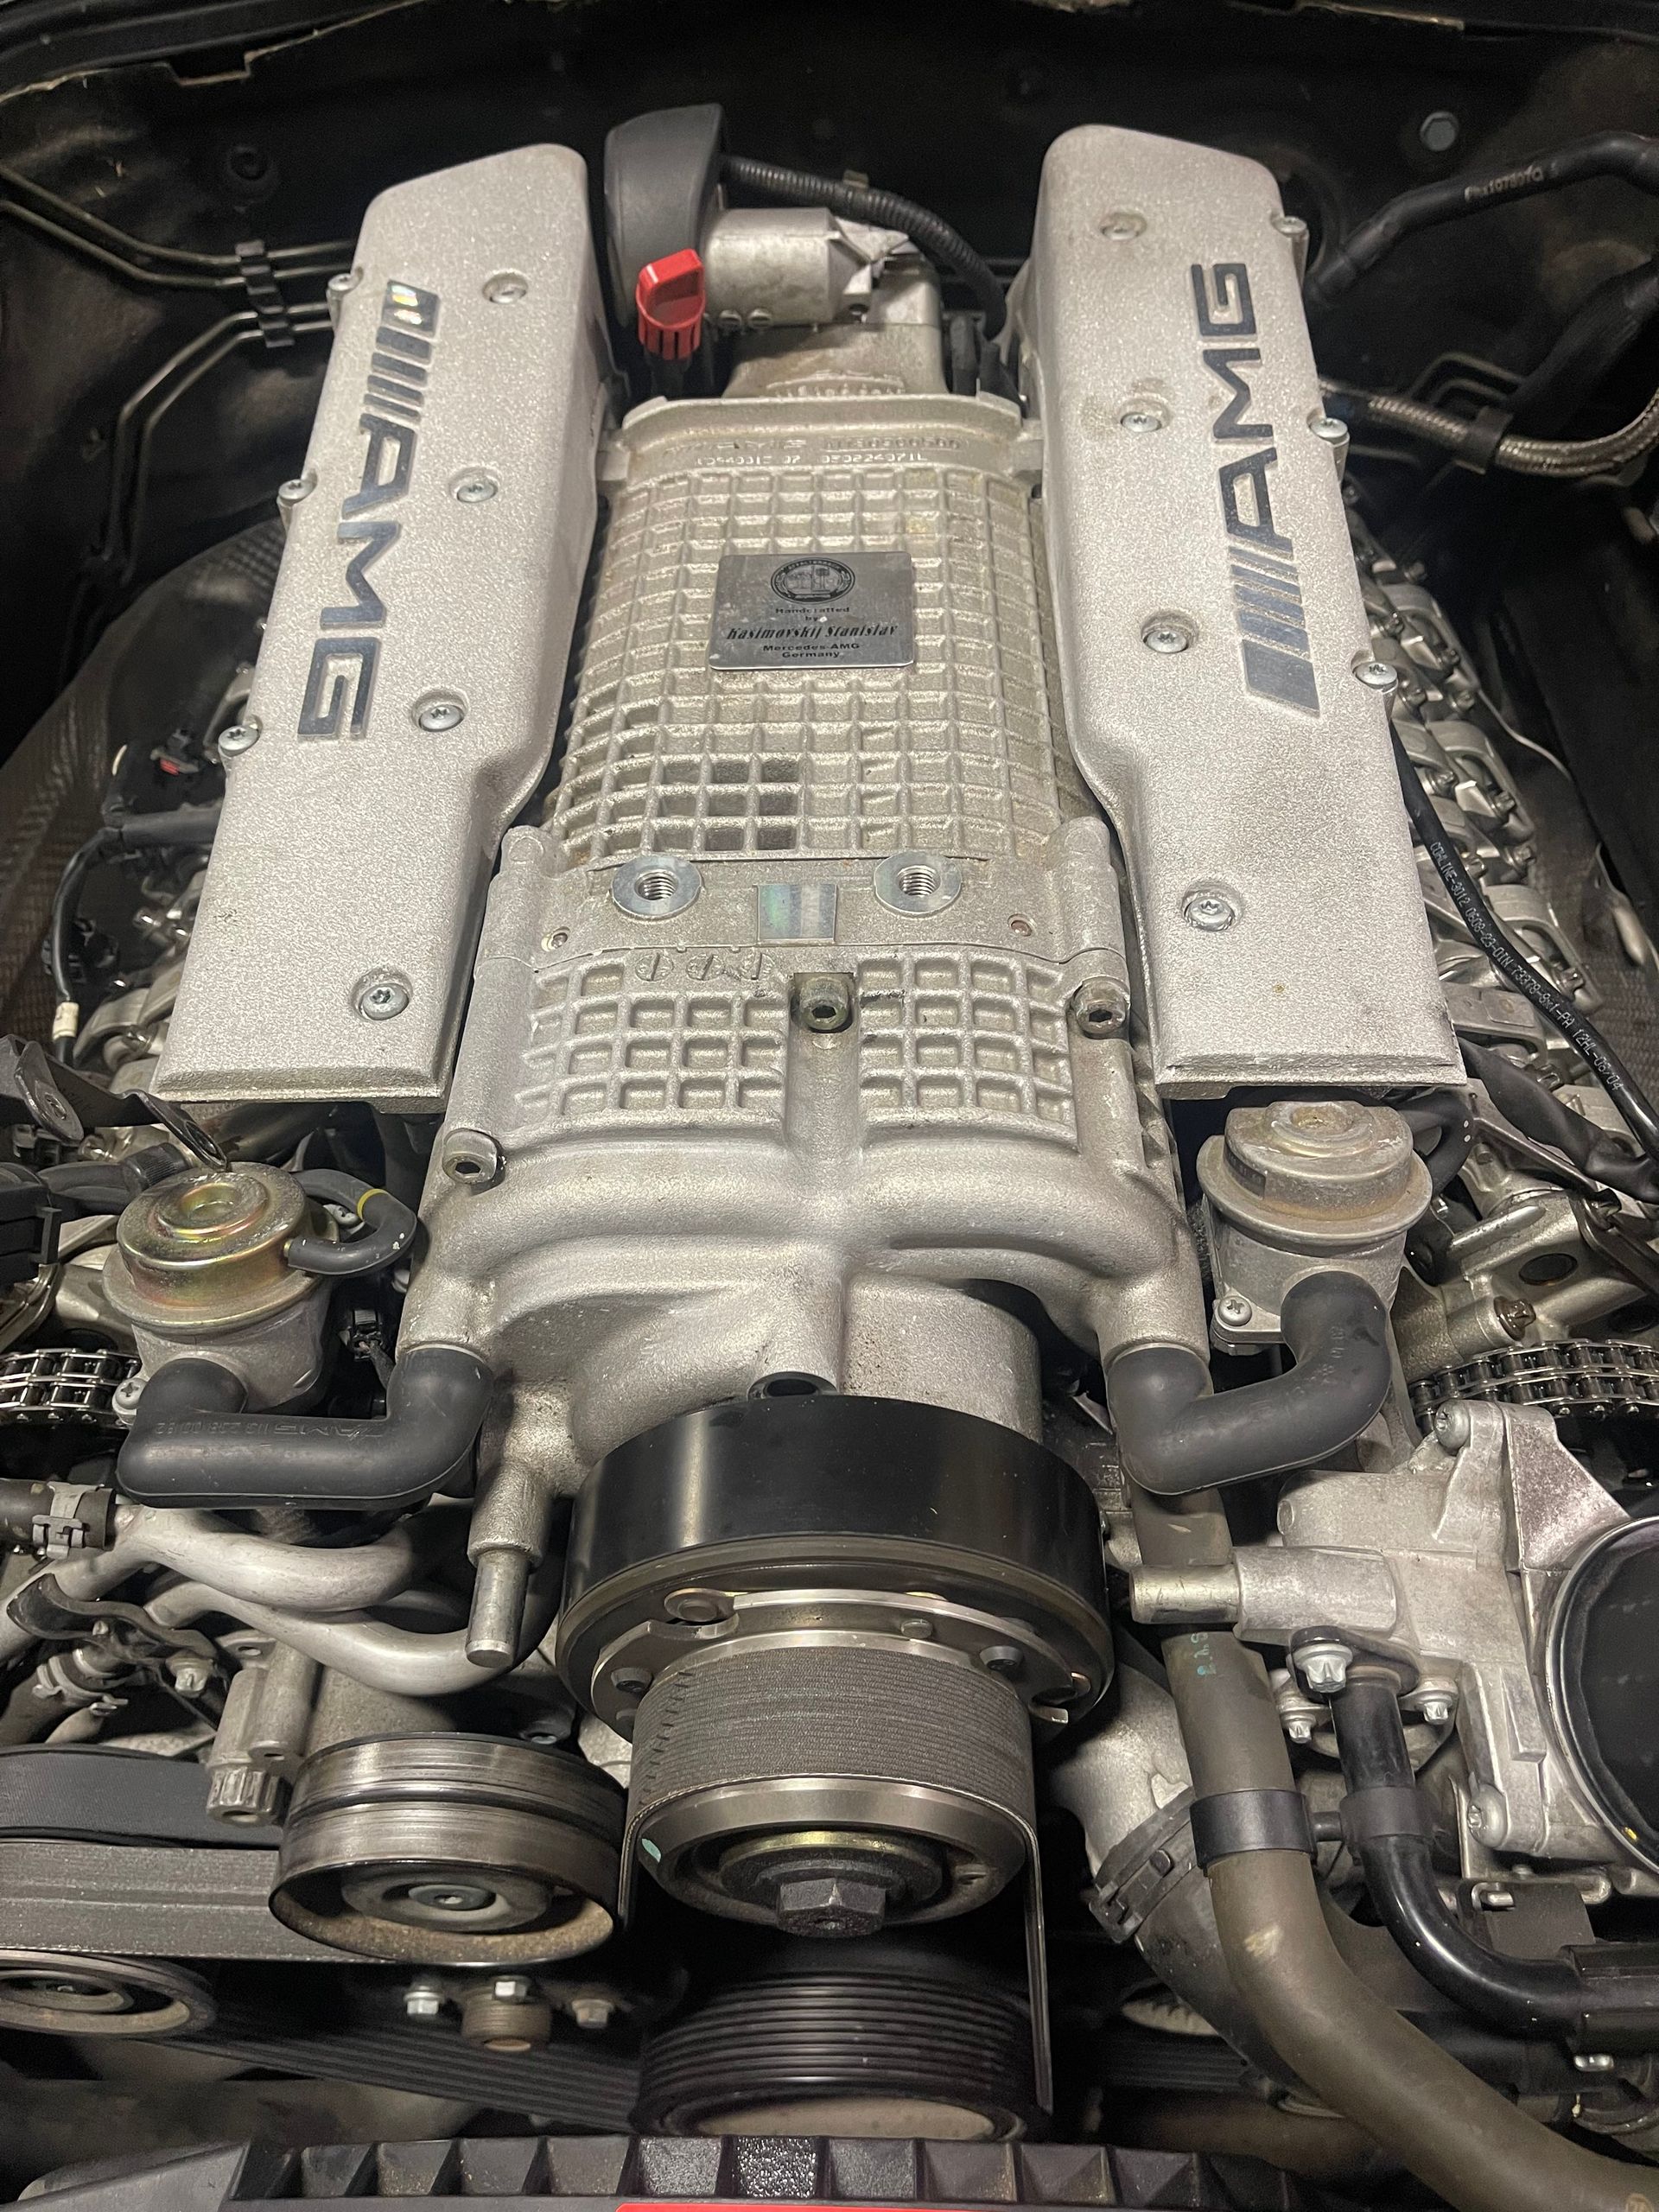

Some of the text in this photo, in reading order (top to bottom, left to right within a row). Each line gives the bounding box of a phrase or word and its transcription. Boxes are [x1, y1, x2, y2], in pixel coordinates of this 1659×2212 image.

[1191, 263, 1294, 554] AMG
[298, 413, 417, 740] AMG
[824, 625, 898, 638] Stanislav
